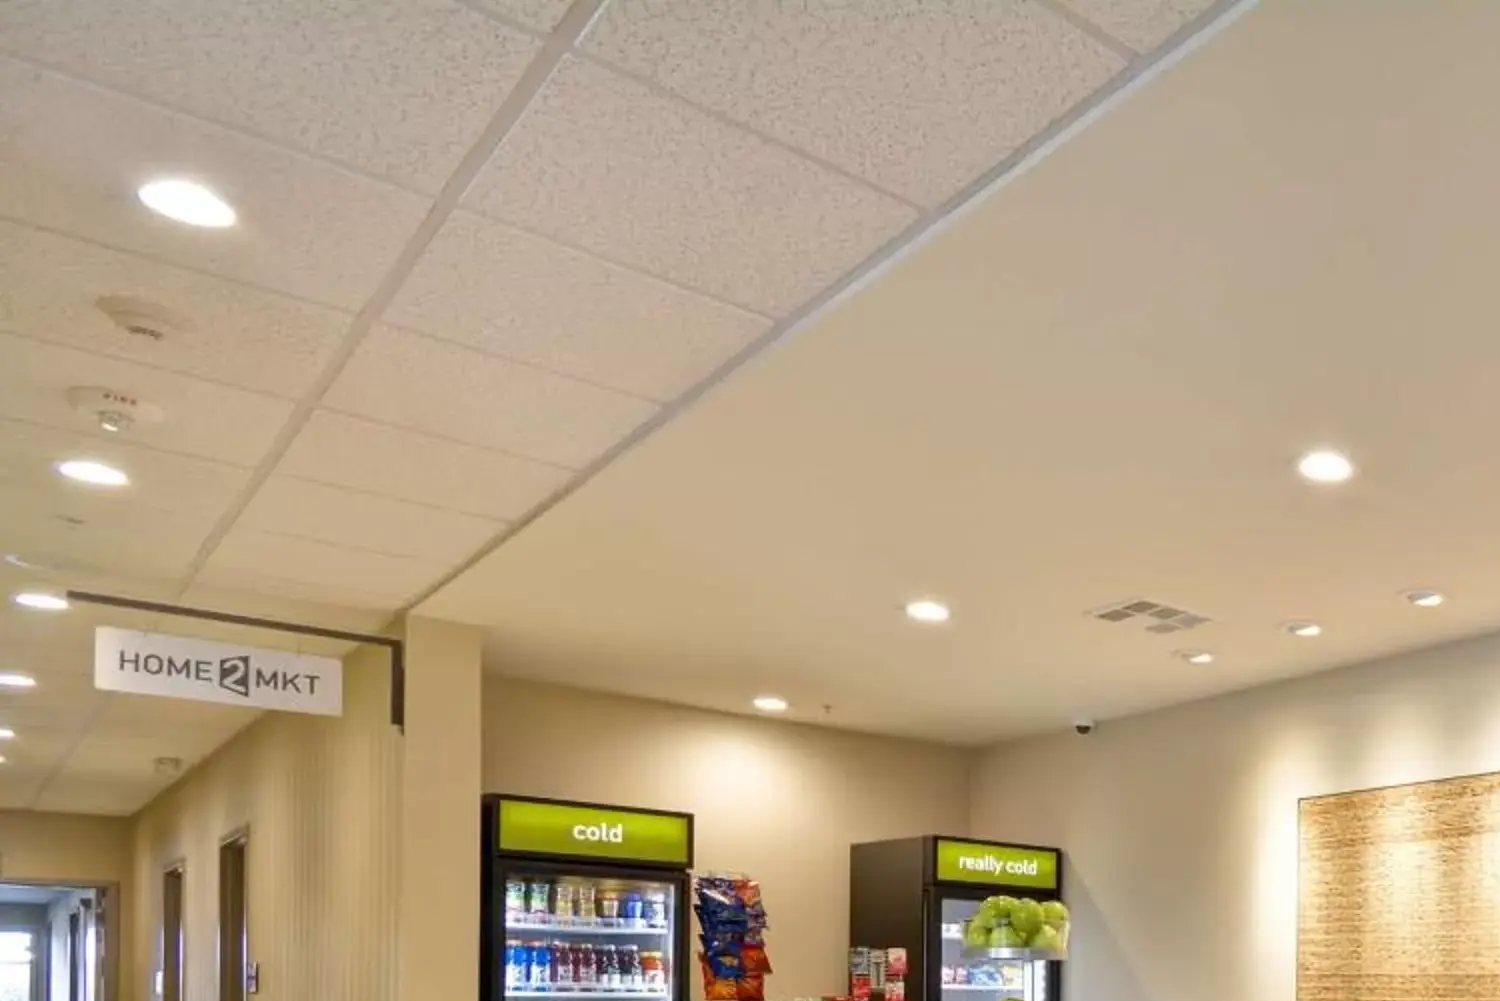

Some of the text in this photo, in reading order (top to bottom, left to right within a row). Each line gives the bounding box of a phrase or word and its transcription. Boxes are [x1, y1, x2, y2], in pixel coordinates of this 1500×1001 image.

[572, 821, 623, 843] cold
[959, 853, 1038, 877] really cold
